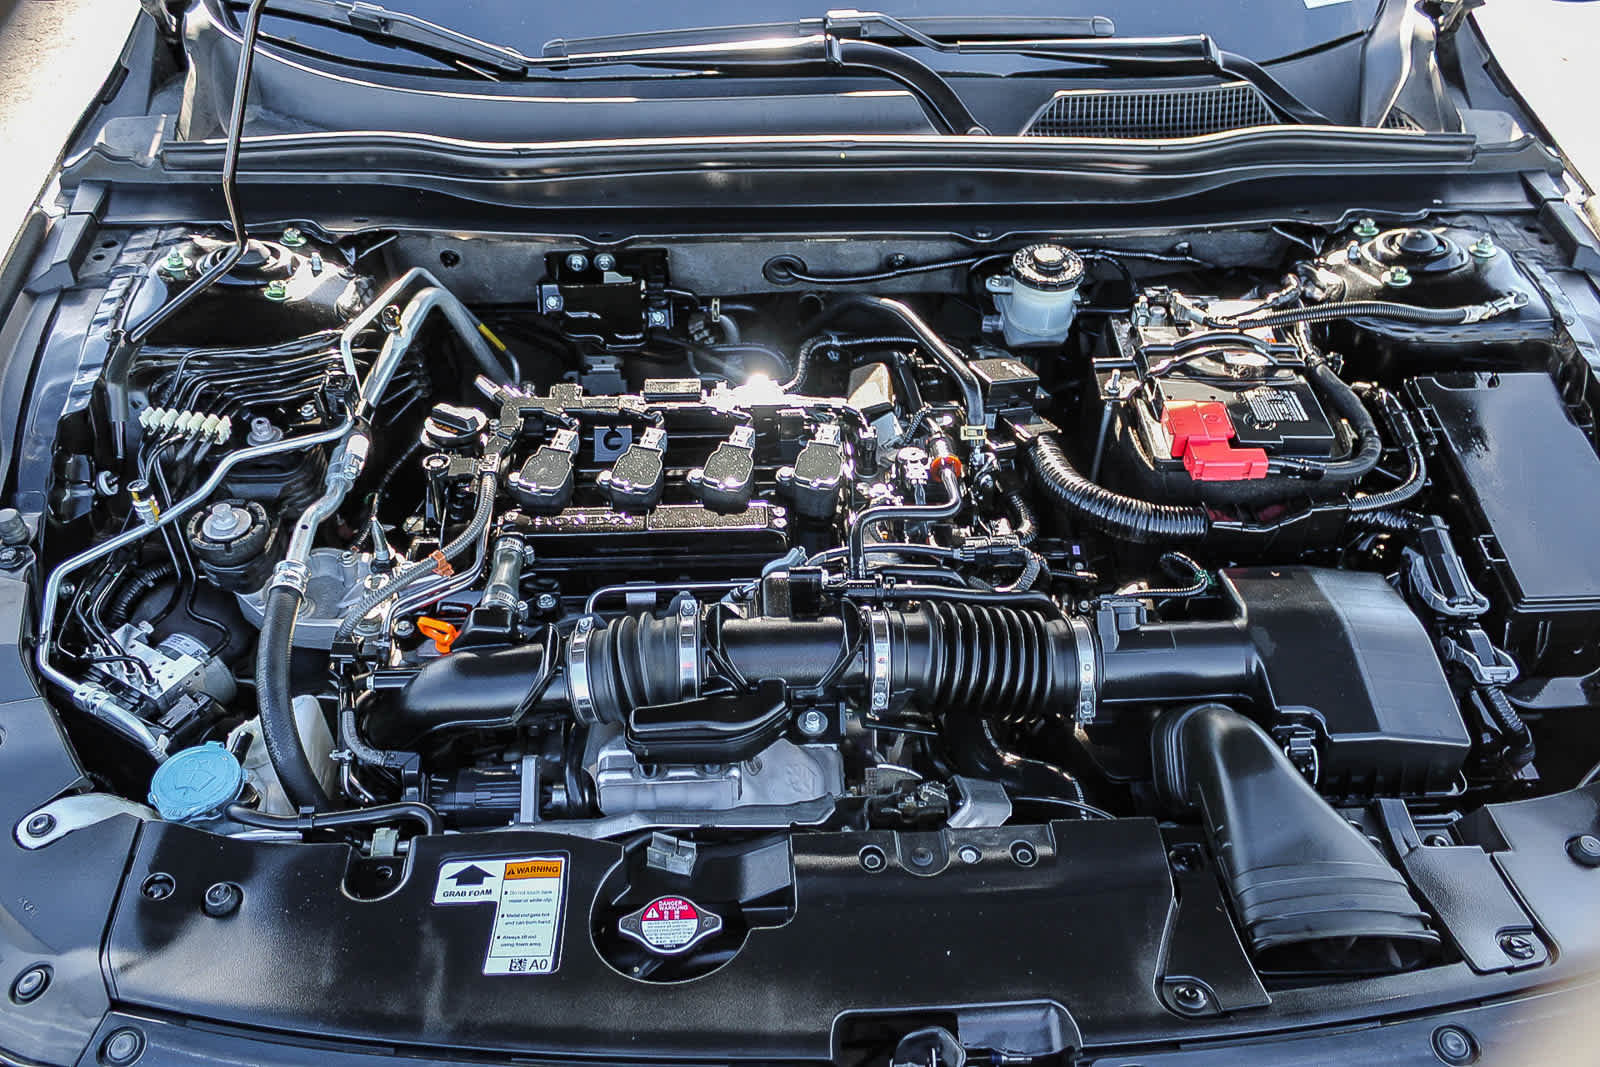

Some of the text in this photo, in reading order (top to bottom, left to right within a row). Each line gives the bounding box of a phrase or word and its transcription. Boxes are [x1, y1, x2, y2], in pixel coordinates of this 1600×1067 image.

[516, 865, 559, 875] WARNING
[442, 888, 493, 898] GRAB FOAM
[528, 958, 548, 971] A0
